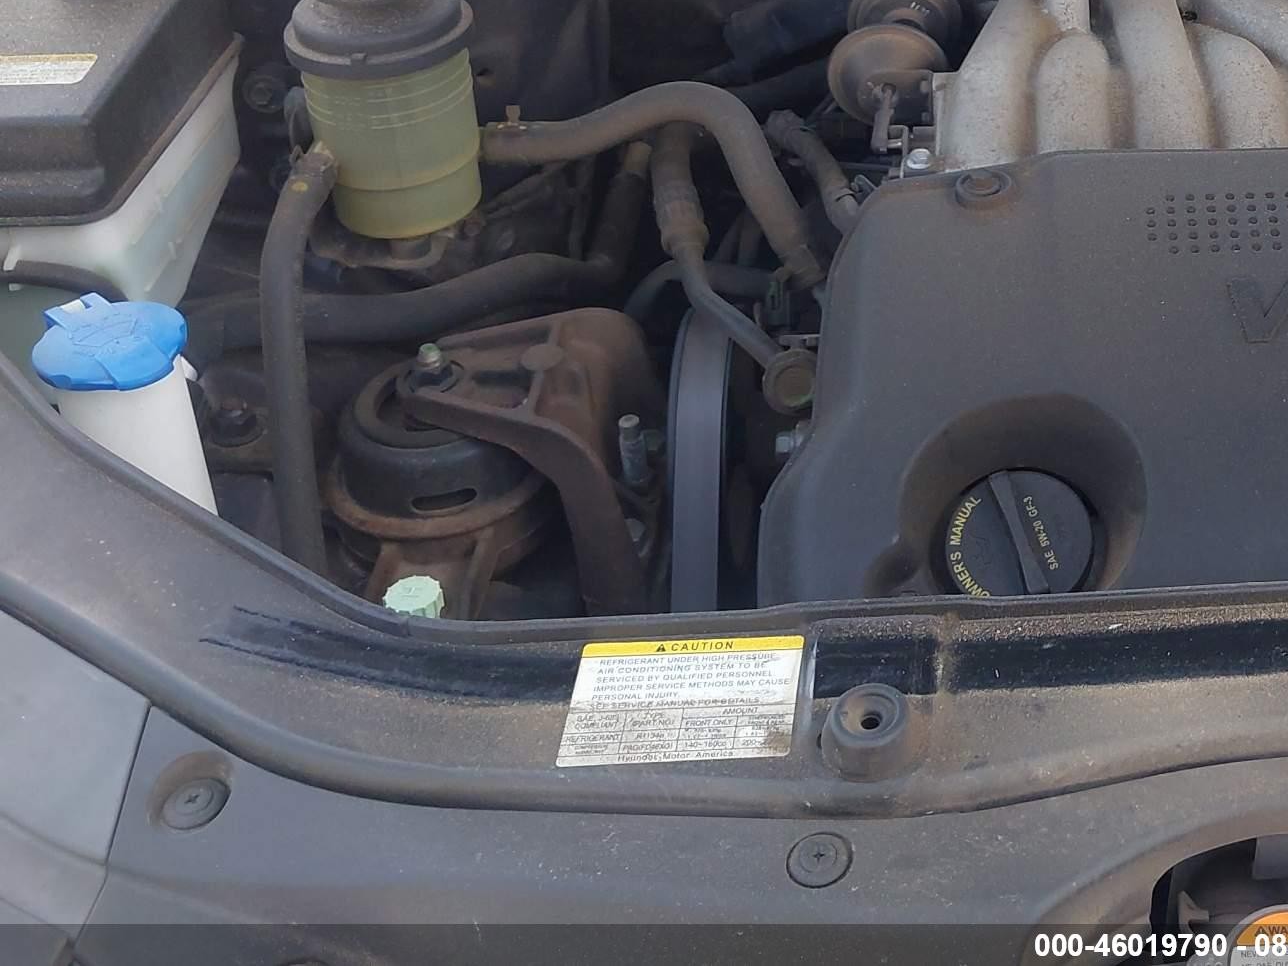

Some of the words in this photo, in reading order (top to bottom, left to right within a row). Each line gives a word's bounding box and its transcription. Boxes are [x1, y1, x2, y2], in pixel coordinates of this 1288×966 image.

[1024, 496, 1038, 517] GF-3
[950, 496, 982, 545] MANUAL
[1033, 521, 1050, 547] 5W-20
[1045, 549, 1059, 570] SAE
[671, 641, 734, 652] CAUTION
[600, 657, 664, 665] REFRIGERANT
[597, 667, 615, 675] AIR
[618, 664, 691, 674] CONDITIONING
[695, 663, 734, 671] SYSTEM
[754, 661, 767, 669] BE
[597, 675, 644, 684] SERVICED
[648, 674, 659, 682] BY
[663, 672, 713, 681] QUALIFIED
[593, 684, 643, 692] IMPROPER
[646, 682, 686, 690] SERVICE
[688, 680, 734, 689] METHODS
[736, 679, 756, 687] MAY
[758, 678, 791, 686] CAUSE
[592, 693, 642, 701] PERSONAL
[612, 700, 653, 709] SERVICE
[685, 719, 712, 727] FRONT
[565, 734, 620, 742] REFRIGERANT
[662, 752, 690, 760] Motor
[695, 750, 734, 758] America
